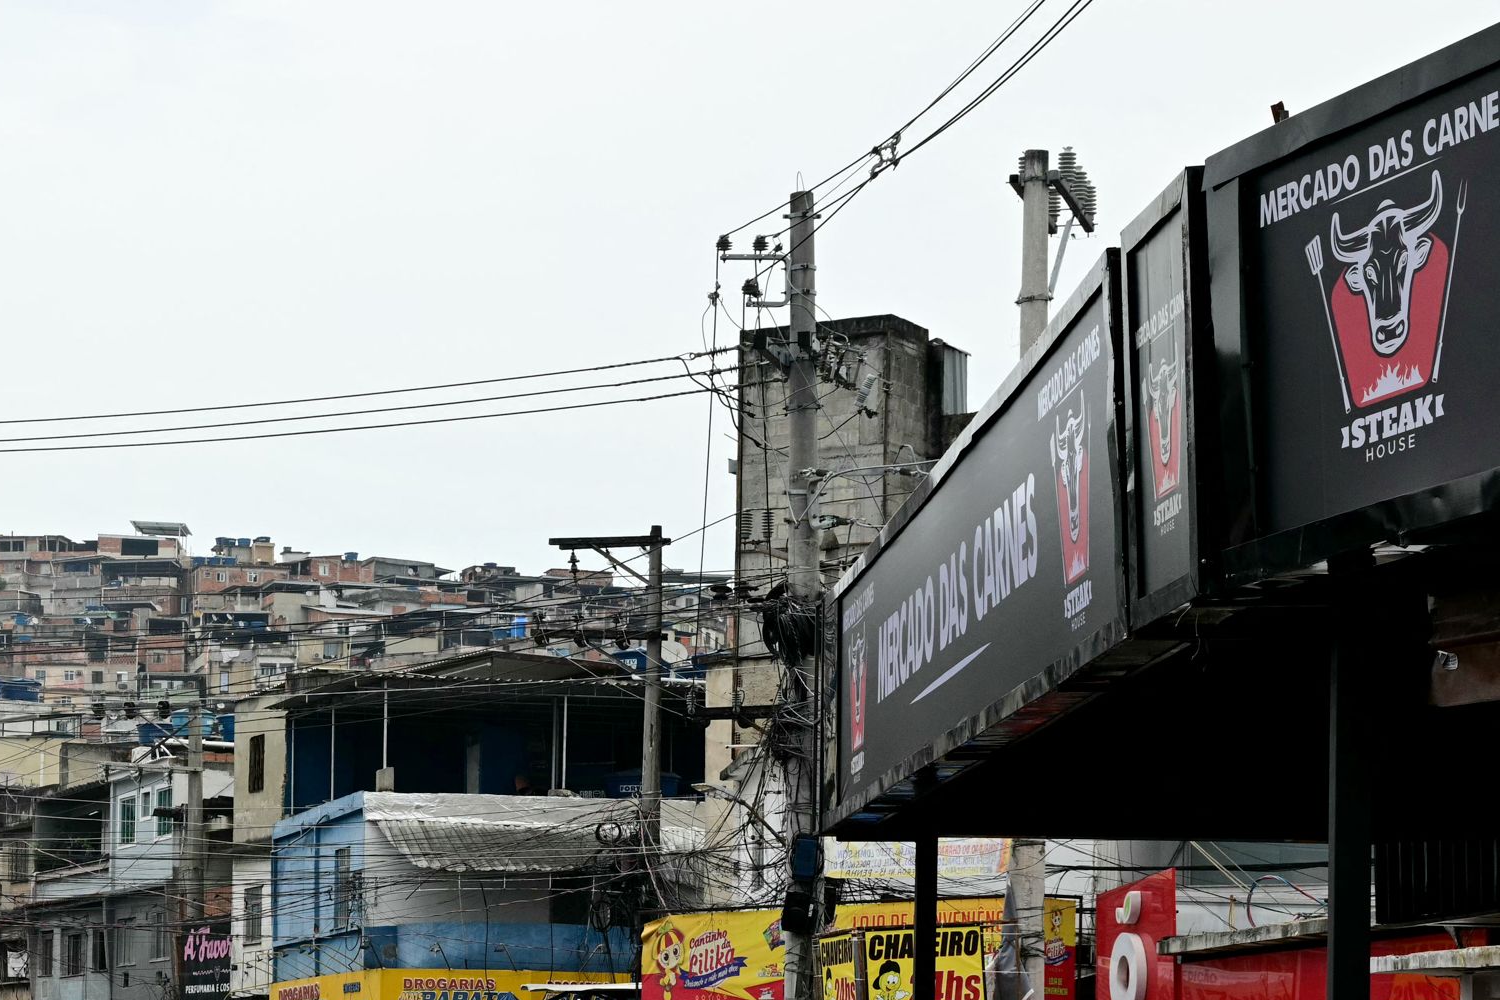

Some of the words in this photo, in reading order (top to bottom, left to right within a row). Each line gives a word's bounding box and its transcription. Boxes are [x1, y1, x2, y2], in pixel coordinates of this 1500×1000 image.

[1260, 154, 1360, 228] MERCADO
[1369, 129, 1413, 181] DAS
[1422, 90, 1500, 155] CARNE
[1037, 372, 1063, 422] MERCADO
[1064, 351, 1077, 390] DAS
[1077, 325, 1100, 375] CARNES
[1351, 394, 1433, 448] STEAK
[1366, 434, 1416, 462] HOUSE
[877, 576, 934, 704] MERCADO
[939, 542, 968, 651] DAS
[973, 473, 1038, 621] CARNES
[689, 929, 728, 949] Cantinho
[721, 939, 731, 949] da
[869, 930, 980, 961] CHAEIRO
[185, 984, 215, 994] PERFUMARIA
[216, 983, 219, 992] E
[403, 978, 496, 990] DROGARIAS
